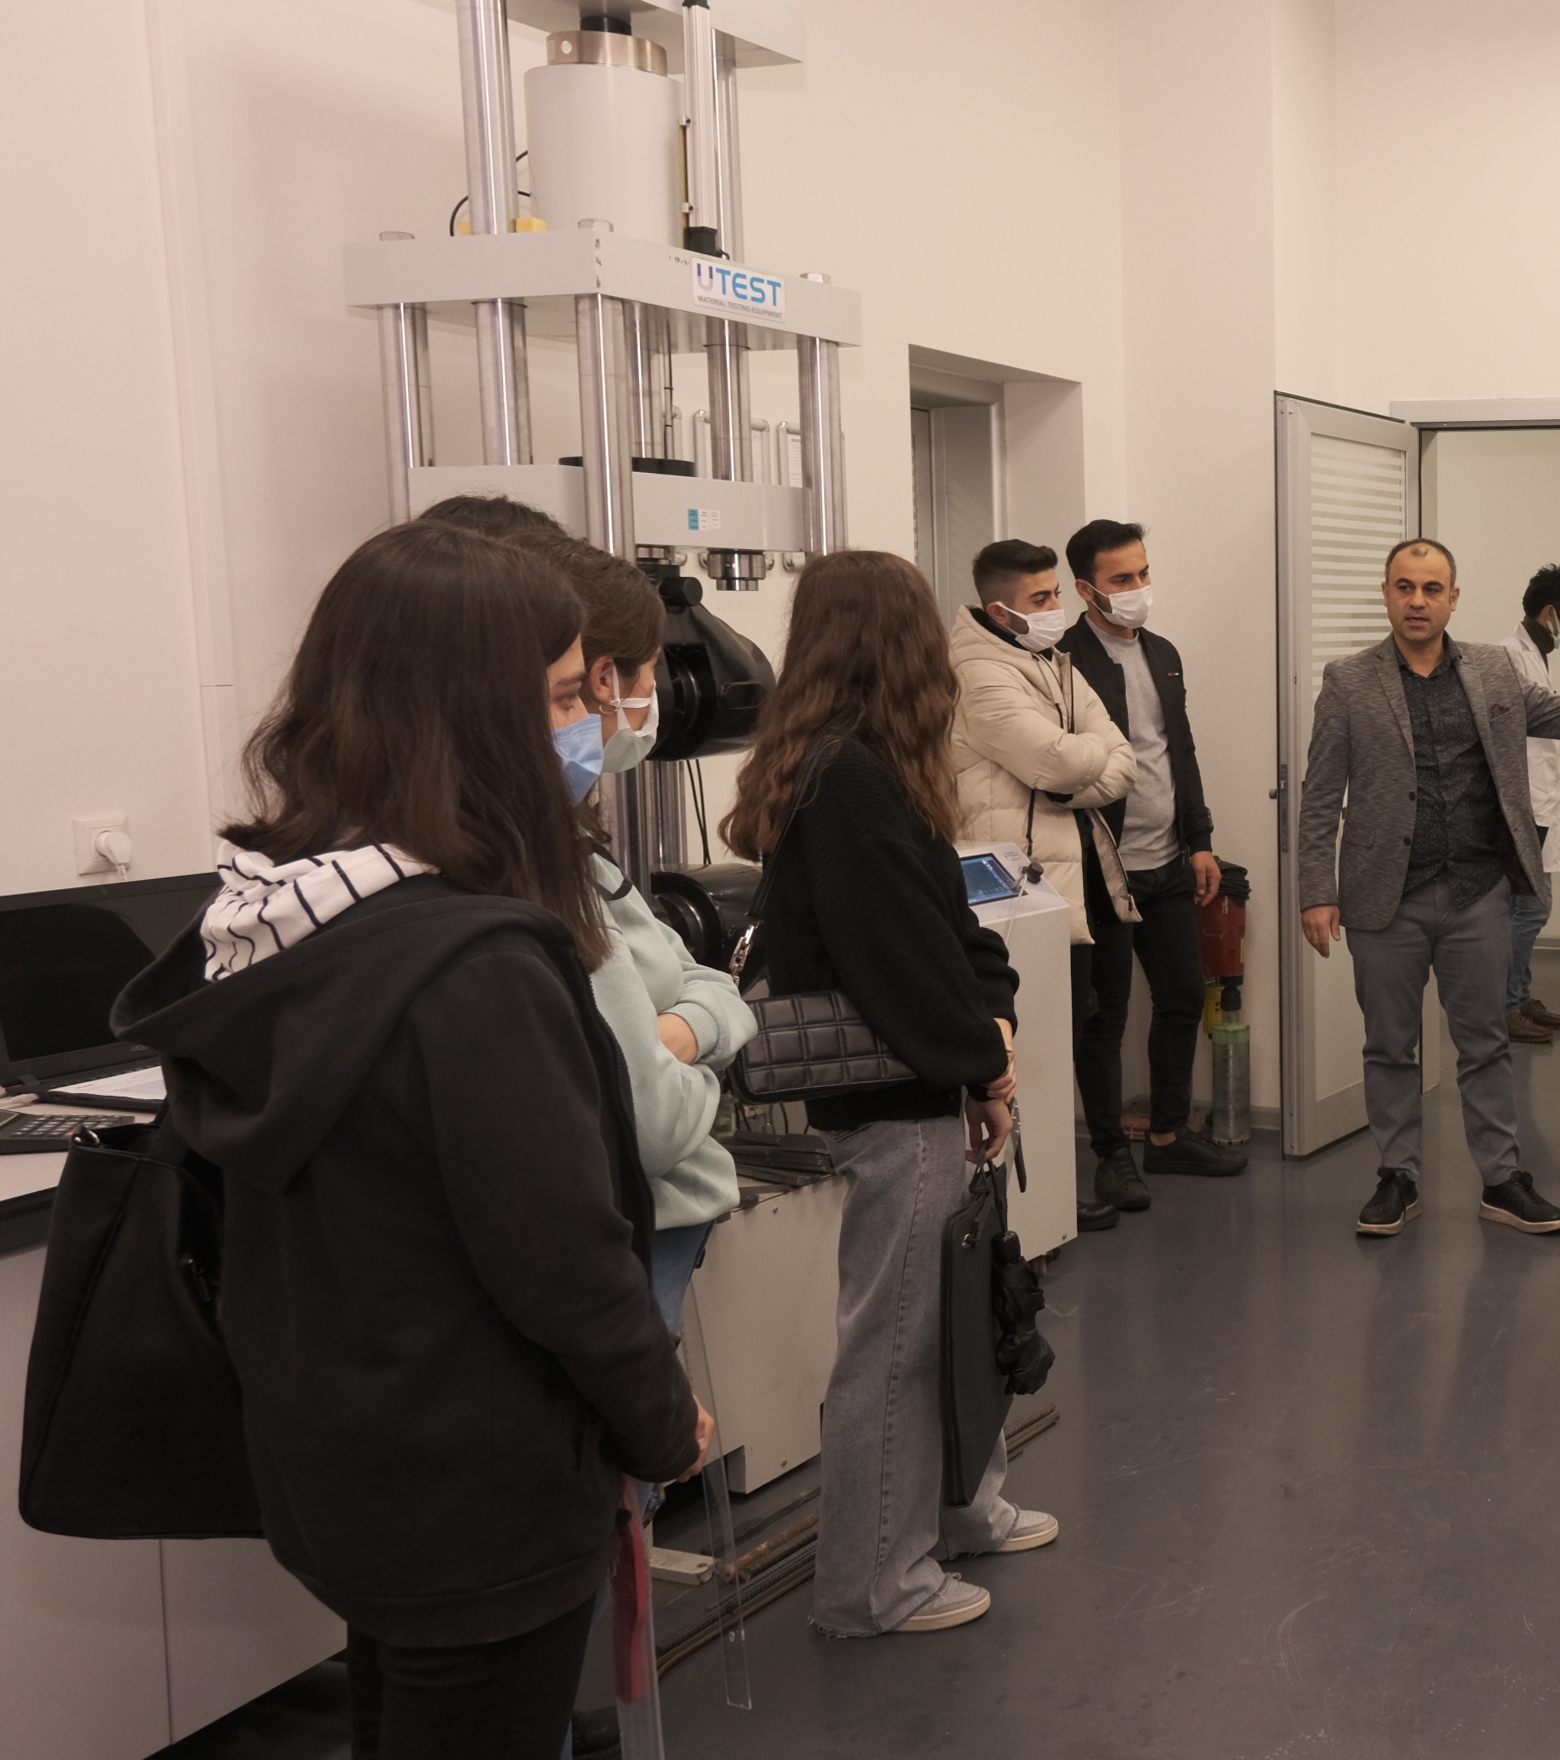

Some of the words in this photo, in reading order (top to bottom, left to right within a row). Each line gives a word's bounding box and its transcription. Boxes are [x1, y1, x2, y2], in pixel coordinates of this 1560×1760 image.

[697, 263, 782, 307] UTEST
[697, 295, 727, 308] MATERIAL
[727, 301, 751, 313] TESTING
[751, 306, 783, 319] EQUIPMENT
